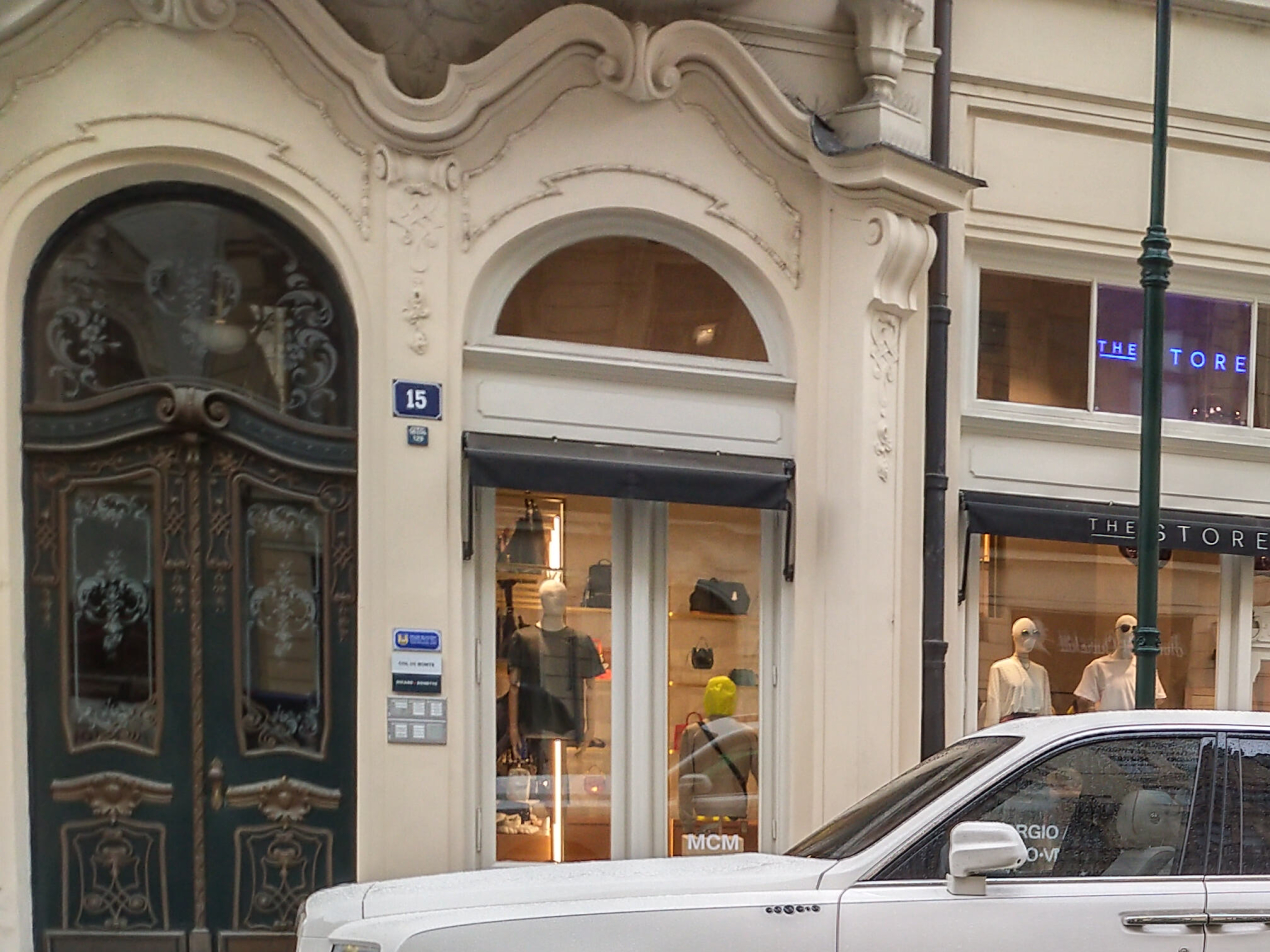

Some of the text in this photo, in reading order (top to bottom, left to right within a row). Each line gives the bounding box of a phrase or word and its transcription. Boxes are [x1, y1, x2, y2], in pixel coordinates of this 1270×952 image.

[1097, 339, 1247, 373] THE TORE
[406, 388, 428, 410] 15
[1088, 517, 1136, 534] THE
[1016, 824, 1059, 840] RGIO
[687, 833, 739, 851] MCM
